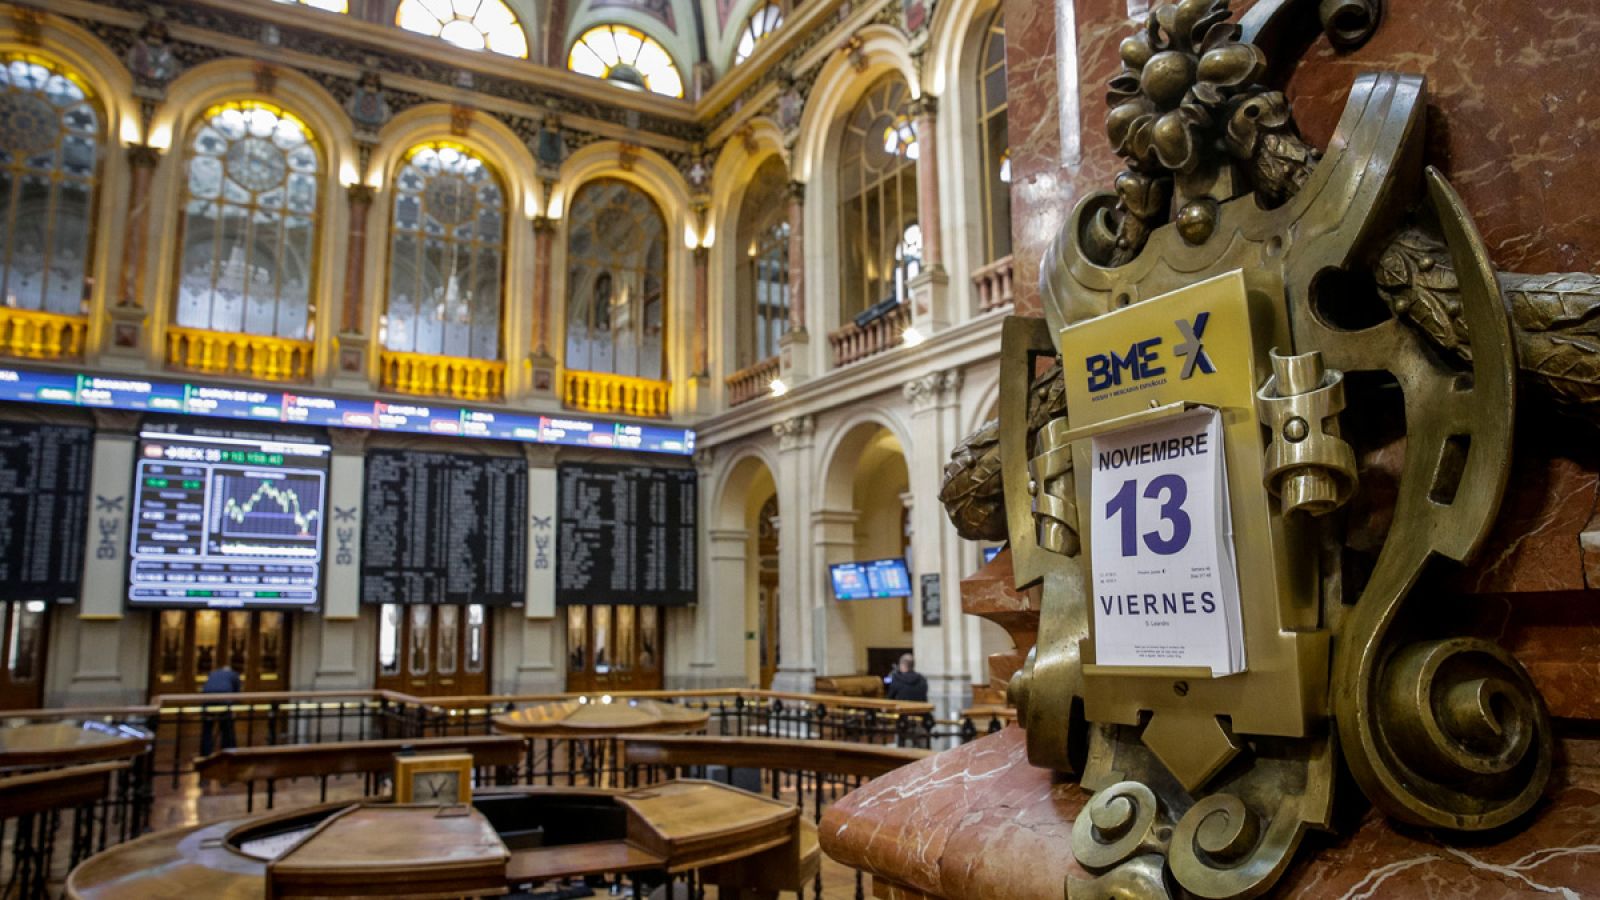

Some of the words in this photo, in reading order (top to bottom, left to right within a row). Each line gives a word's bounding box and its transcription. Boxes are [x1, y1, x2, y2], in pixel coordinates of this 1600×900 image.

[1086, 337, 1165, 392] BME
[1139, 378, 1168, 391] ESPAÑOLES
[1099, 432, 1209, 472] NOVIEMBRE
[1105, 473, 1192, 557] 13
[1099, 591, 1217, 616] VIERNES
